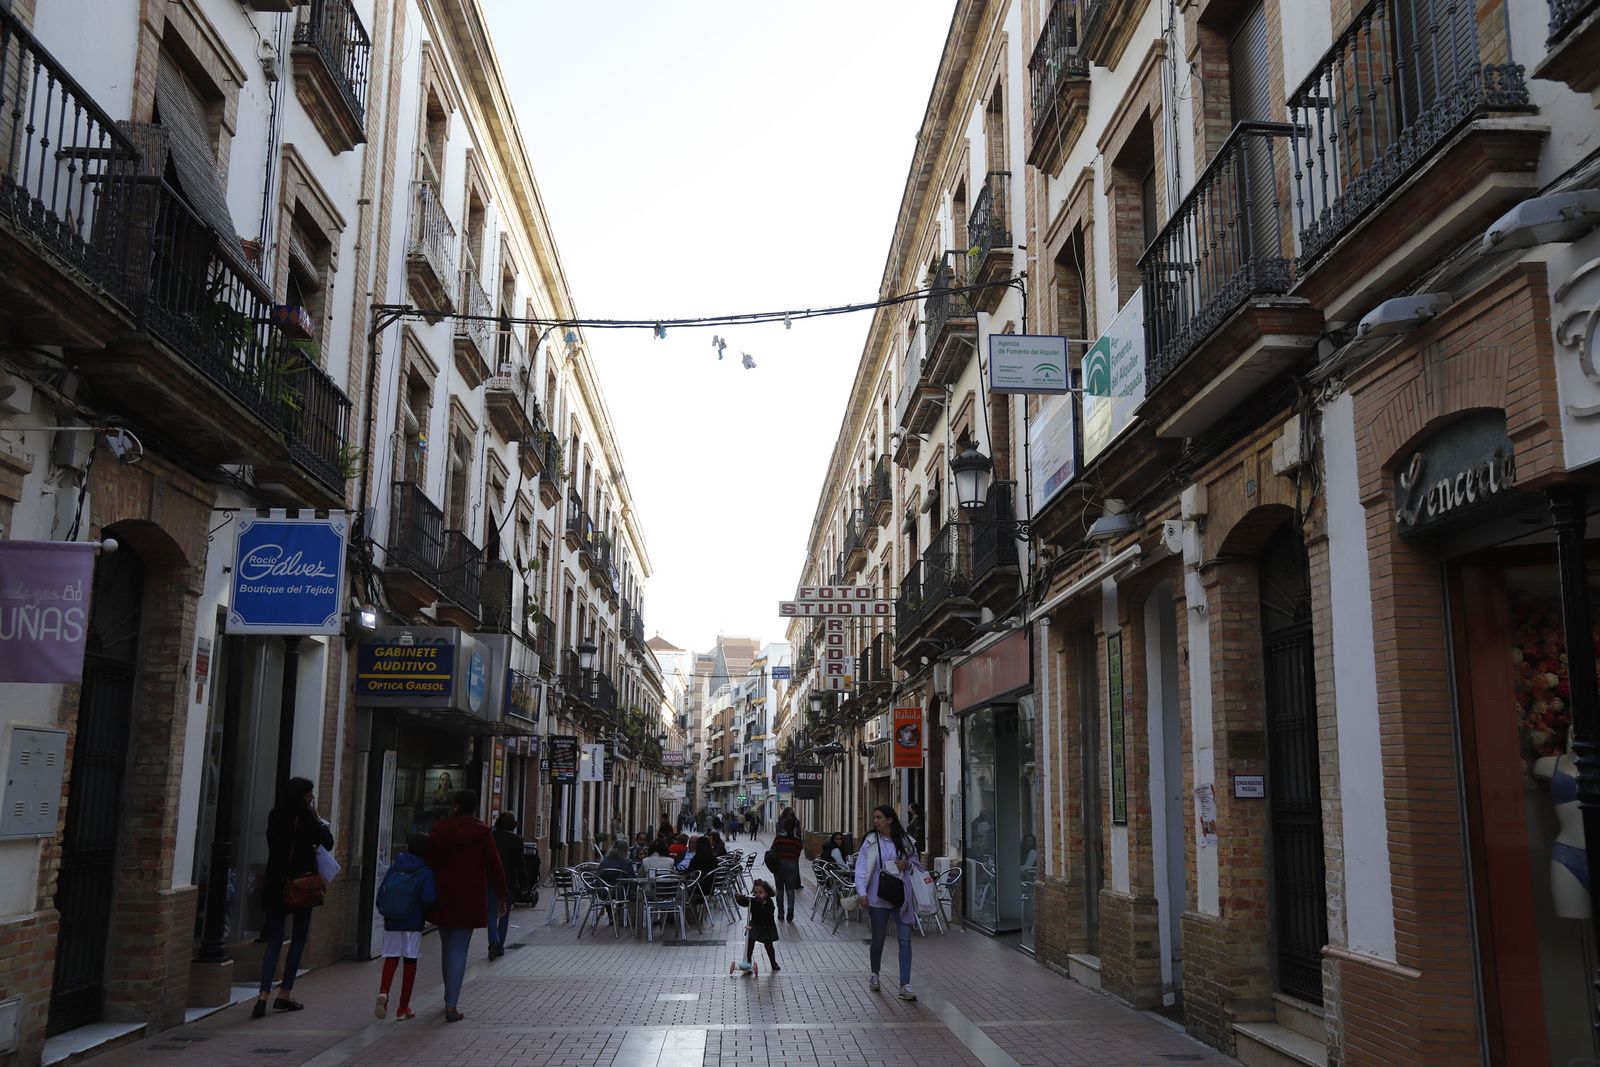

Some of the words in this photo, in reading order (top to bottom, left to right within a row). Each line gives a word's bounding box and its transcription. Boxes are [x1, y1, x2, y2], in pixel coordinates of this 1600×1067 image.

[1040, 349, 1060, 357] Alquiler
[1111, 340, 1133, 368] Fomento
[1119, 354, 1138, 382] Alquiler
[240, 544, 336, 580] Gálvez
[249, 556, 277, 564] Rocío
[239, 584, 284, 595] Boutique
[287, 585, 302, 593] del
[306, 585, 335, 596] Tejido
[800, 587, 872, 599] FOTO
[781, 603, 890, 615] STUDIO
[0, 604, 84, 642] UÑAS
[374, 647, 438, 658] GABINETE
[828, 619, 843, 688] RODRI
[373, 662, 437, 672] AUDITIVO
[368, 681, 403, 690] OPTICA
[406, 682, 444, 691] GARSOL
